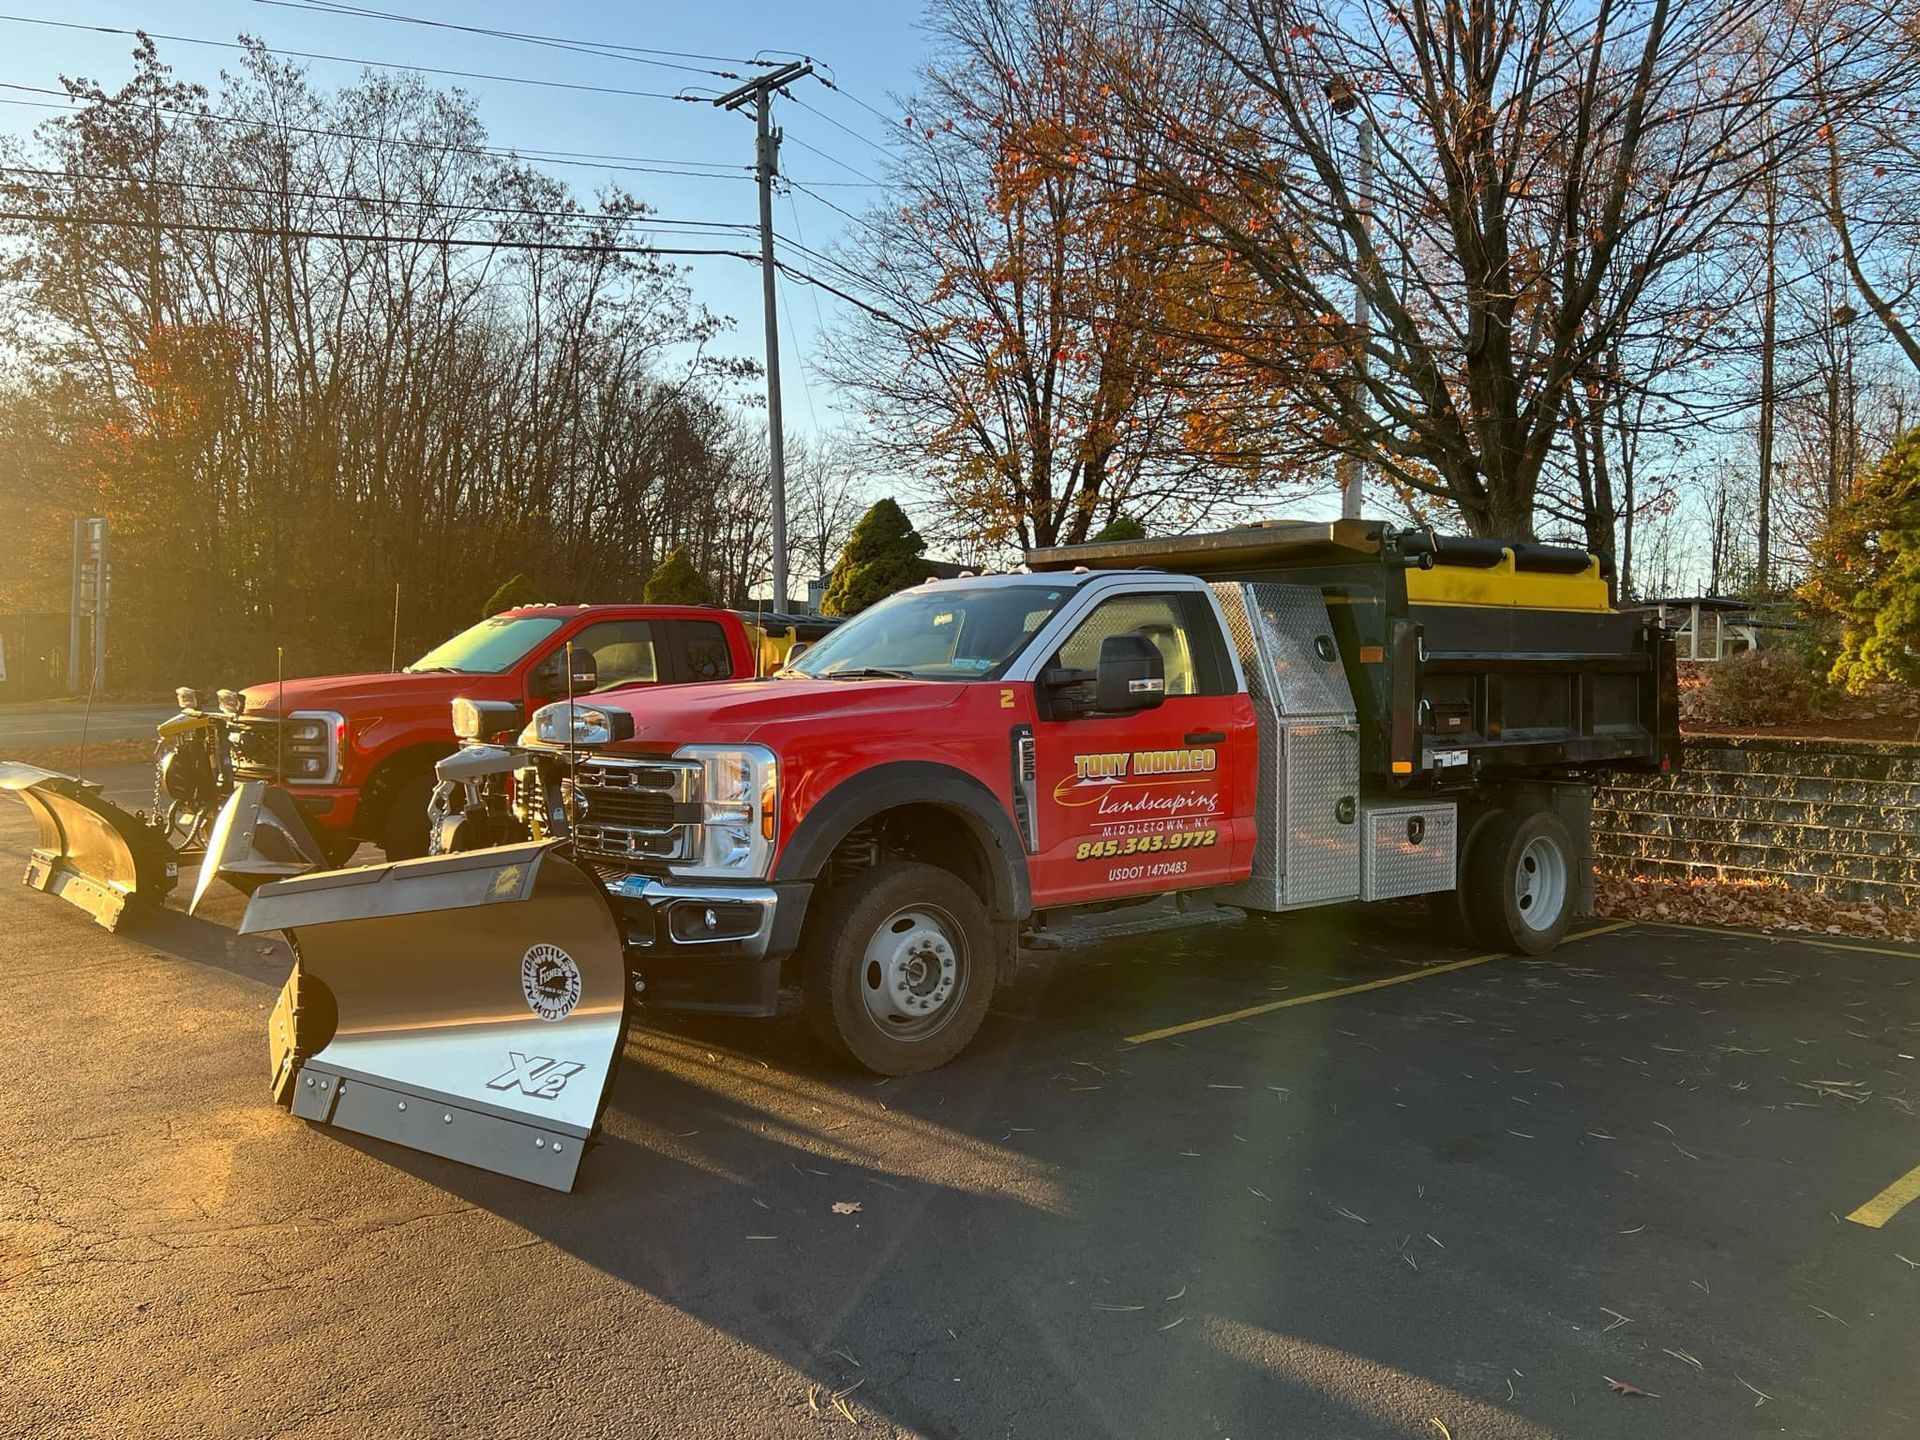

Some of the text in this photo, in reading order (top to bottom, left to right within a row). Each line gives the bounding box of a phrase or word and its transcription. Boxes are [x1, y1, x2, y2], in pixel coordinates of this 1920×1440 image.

[1000, 689, 1015, 708] 2
[1074, 748, 1216, 779] TONY MONACO
[1098, 790, 1220, 815] Landscaping
[1102, 817, 1211, 837] MIDDLETOWN, NY
[1075, 829, 1217, 861] 845.343.9772
[1108, 861, 1188, 881] USDOT 1470483
